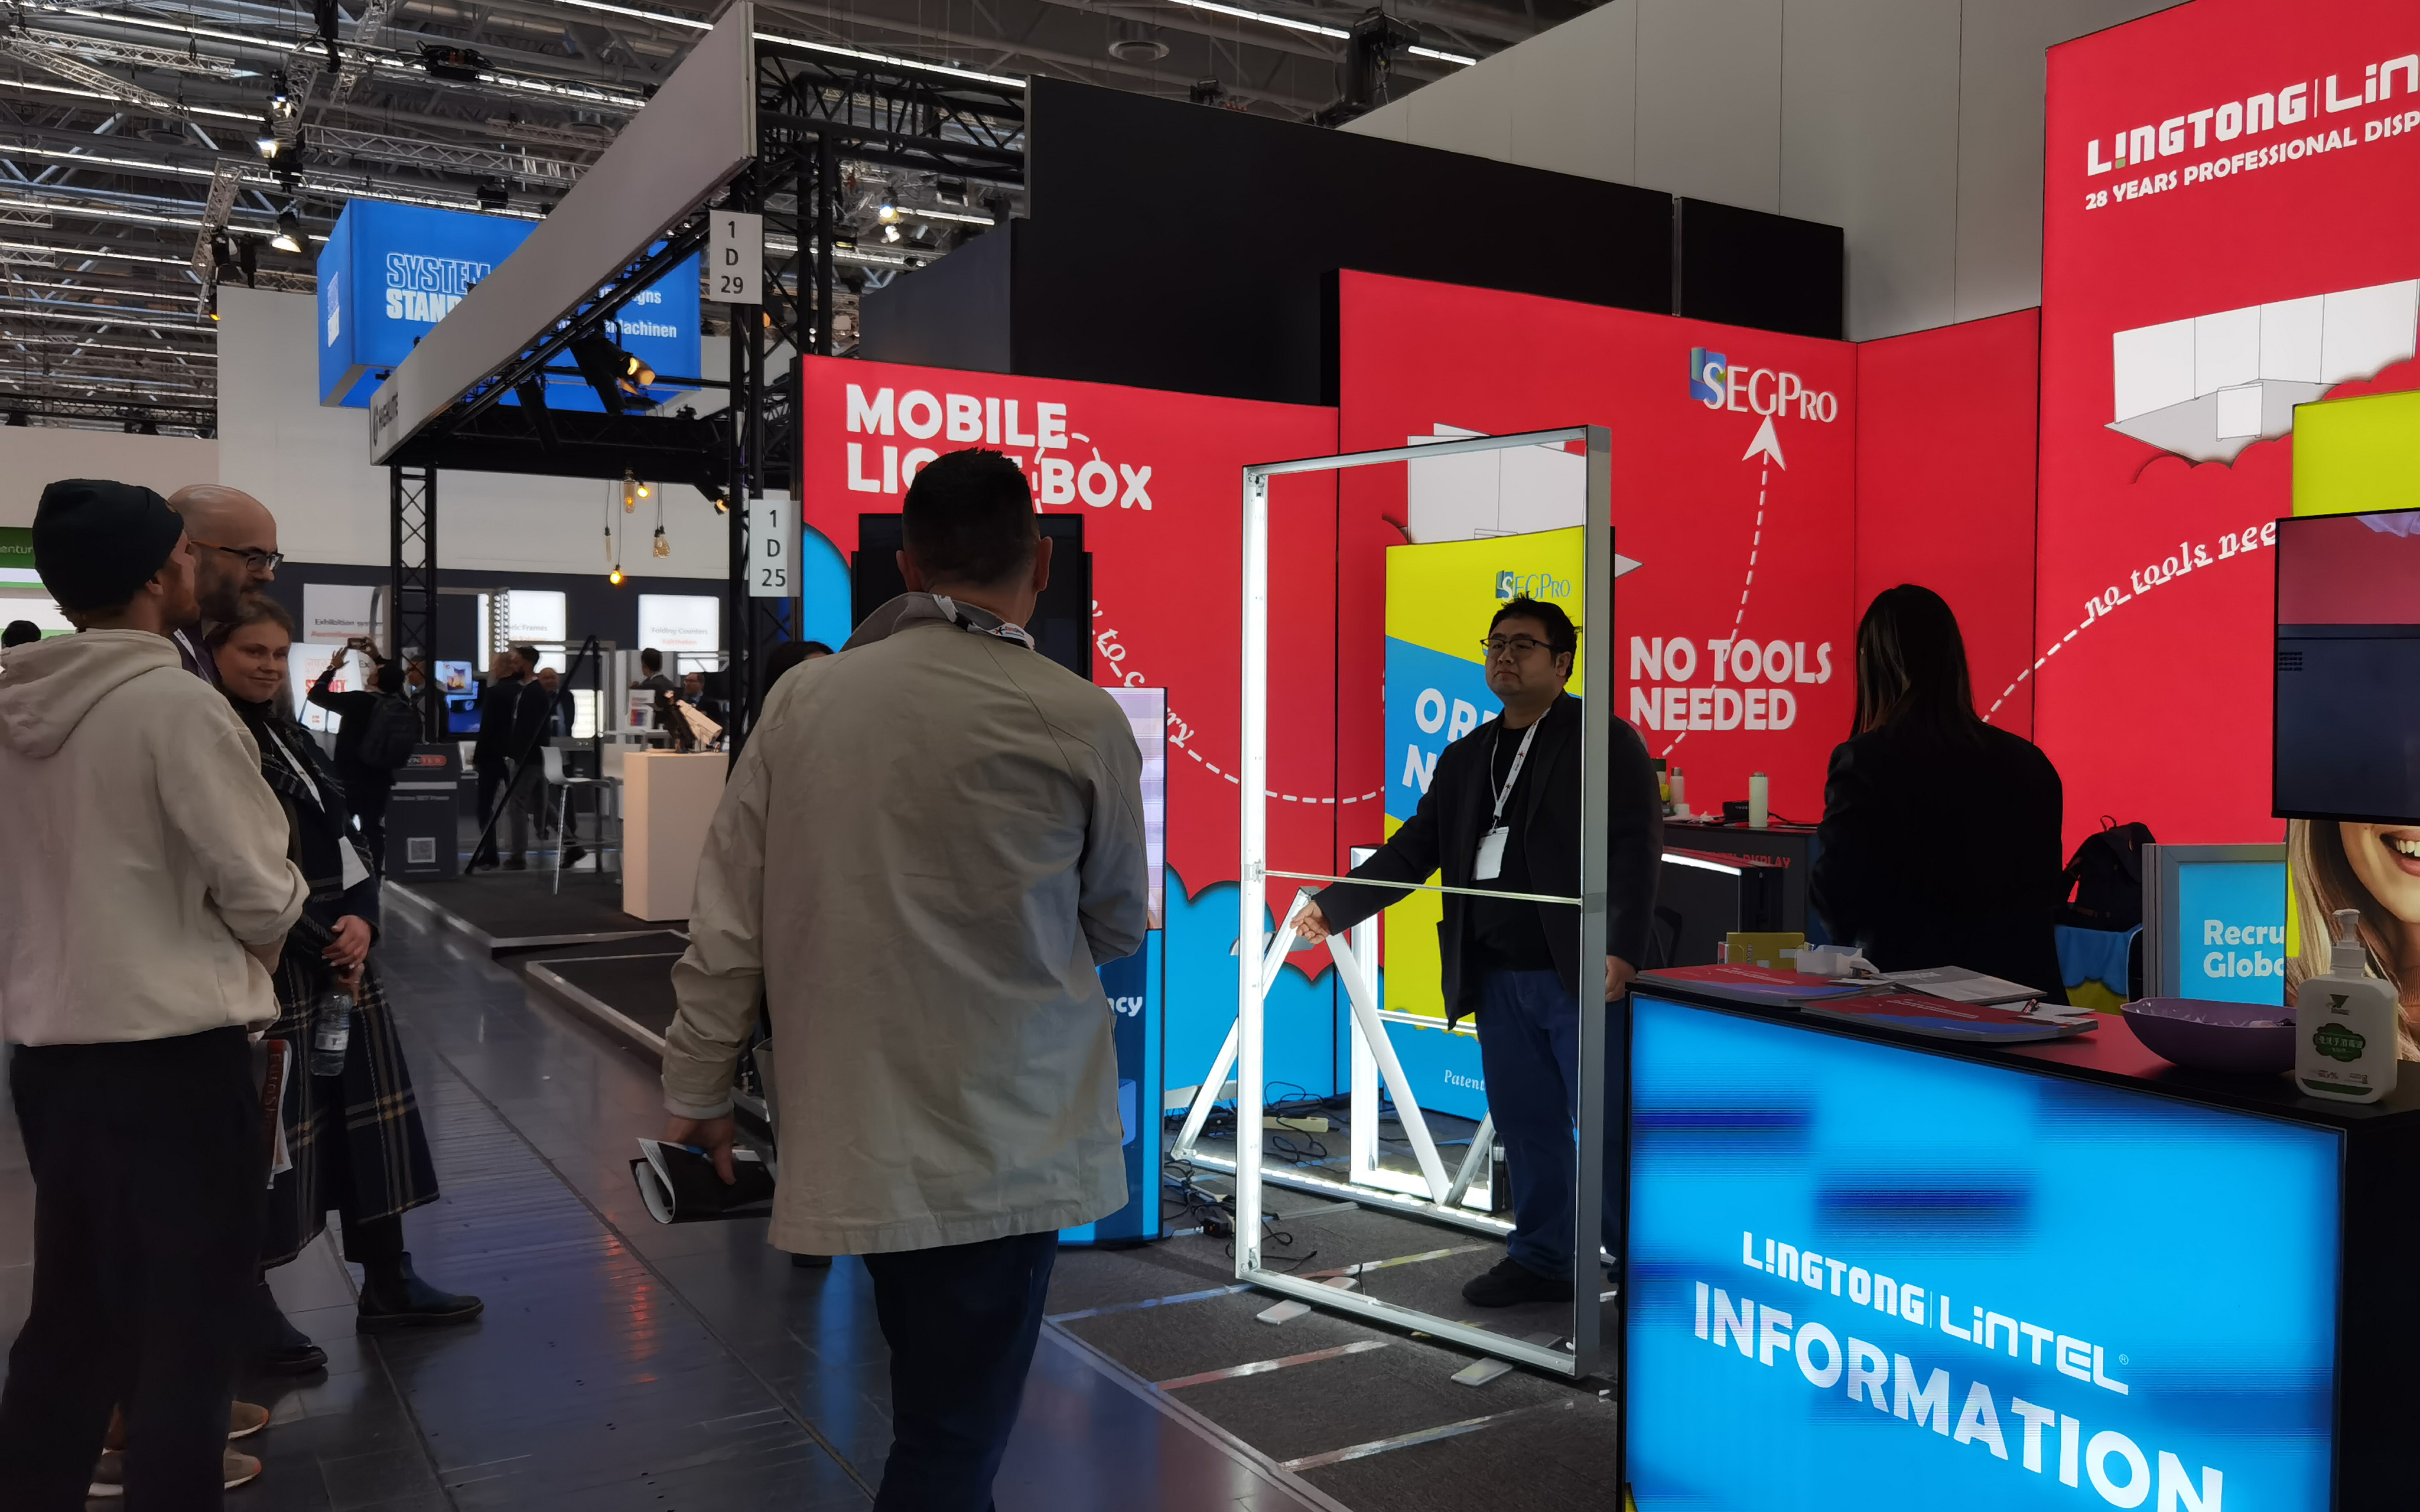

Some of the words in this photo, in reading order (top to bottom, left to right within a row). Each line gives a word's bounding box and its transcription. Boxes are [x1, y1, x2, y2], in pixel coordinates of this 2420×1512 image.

[2086, 190, 2107, 210] 28
[2113, 169, 2177, 201] YEARS
[2184, 126, 2357, 186] PROFESSIONAL
[727, 220, 735, 239] 1
[726, 247, 739, 266] D
[386, 252, 491, 295] SYSTEM
[720, 275, 744, 294] 29
[846, 383, 1068, 449] MOBILE
[1040, 457, 1152, 510] BOX
[769, 510, 777, 528] 1
[767, 539, 781, 557] D
[762, 569, 786, 587] 25
[2085, 586, 2120, 619] no
[2130, 541, 2208, 595] tools
[2219, 522, 2276, 558] nee
[652, 627, 676, 636] Folding
[1630, 636, 1696, 682] NO
[1707, 638, 1832, 685] TOOLS
[1629, 686, 1797, 731] NEEDED
[2204, 925, 2285, 946] Recru
[1694, 1280, 2224, 1512] INFORMATION
